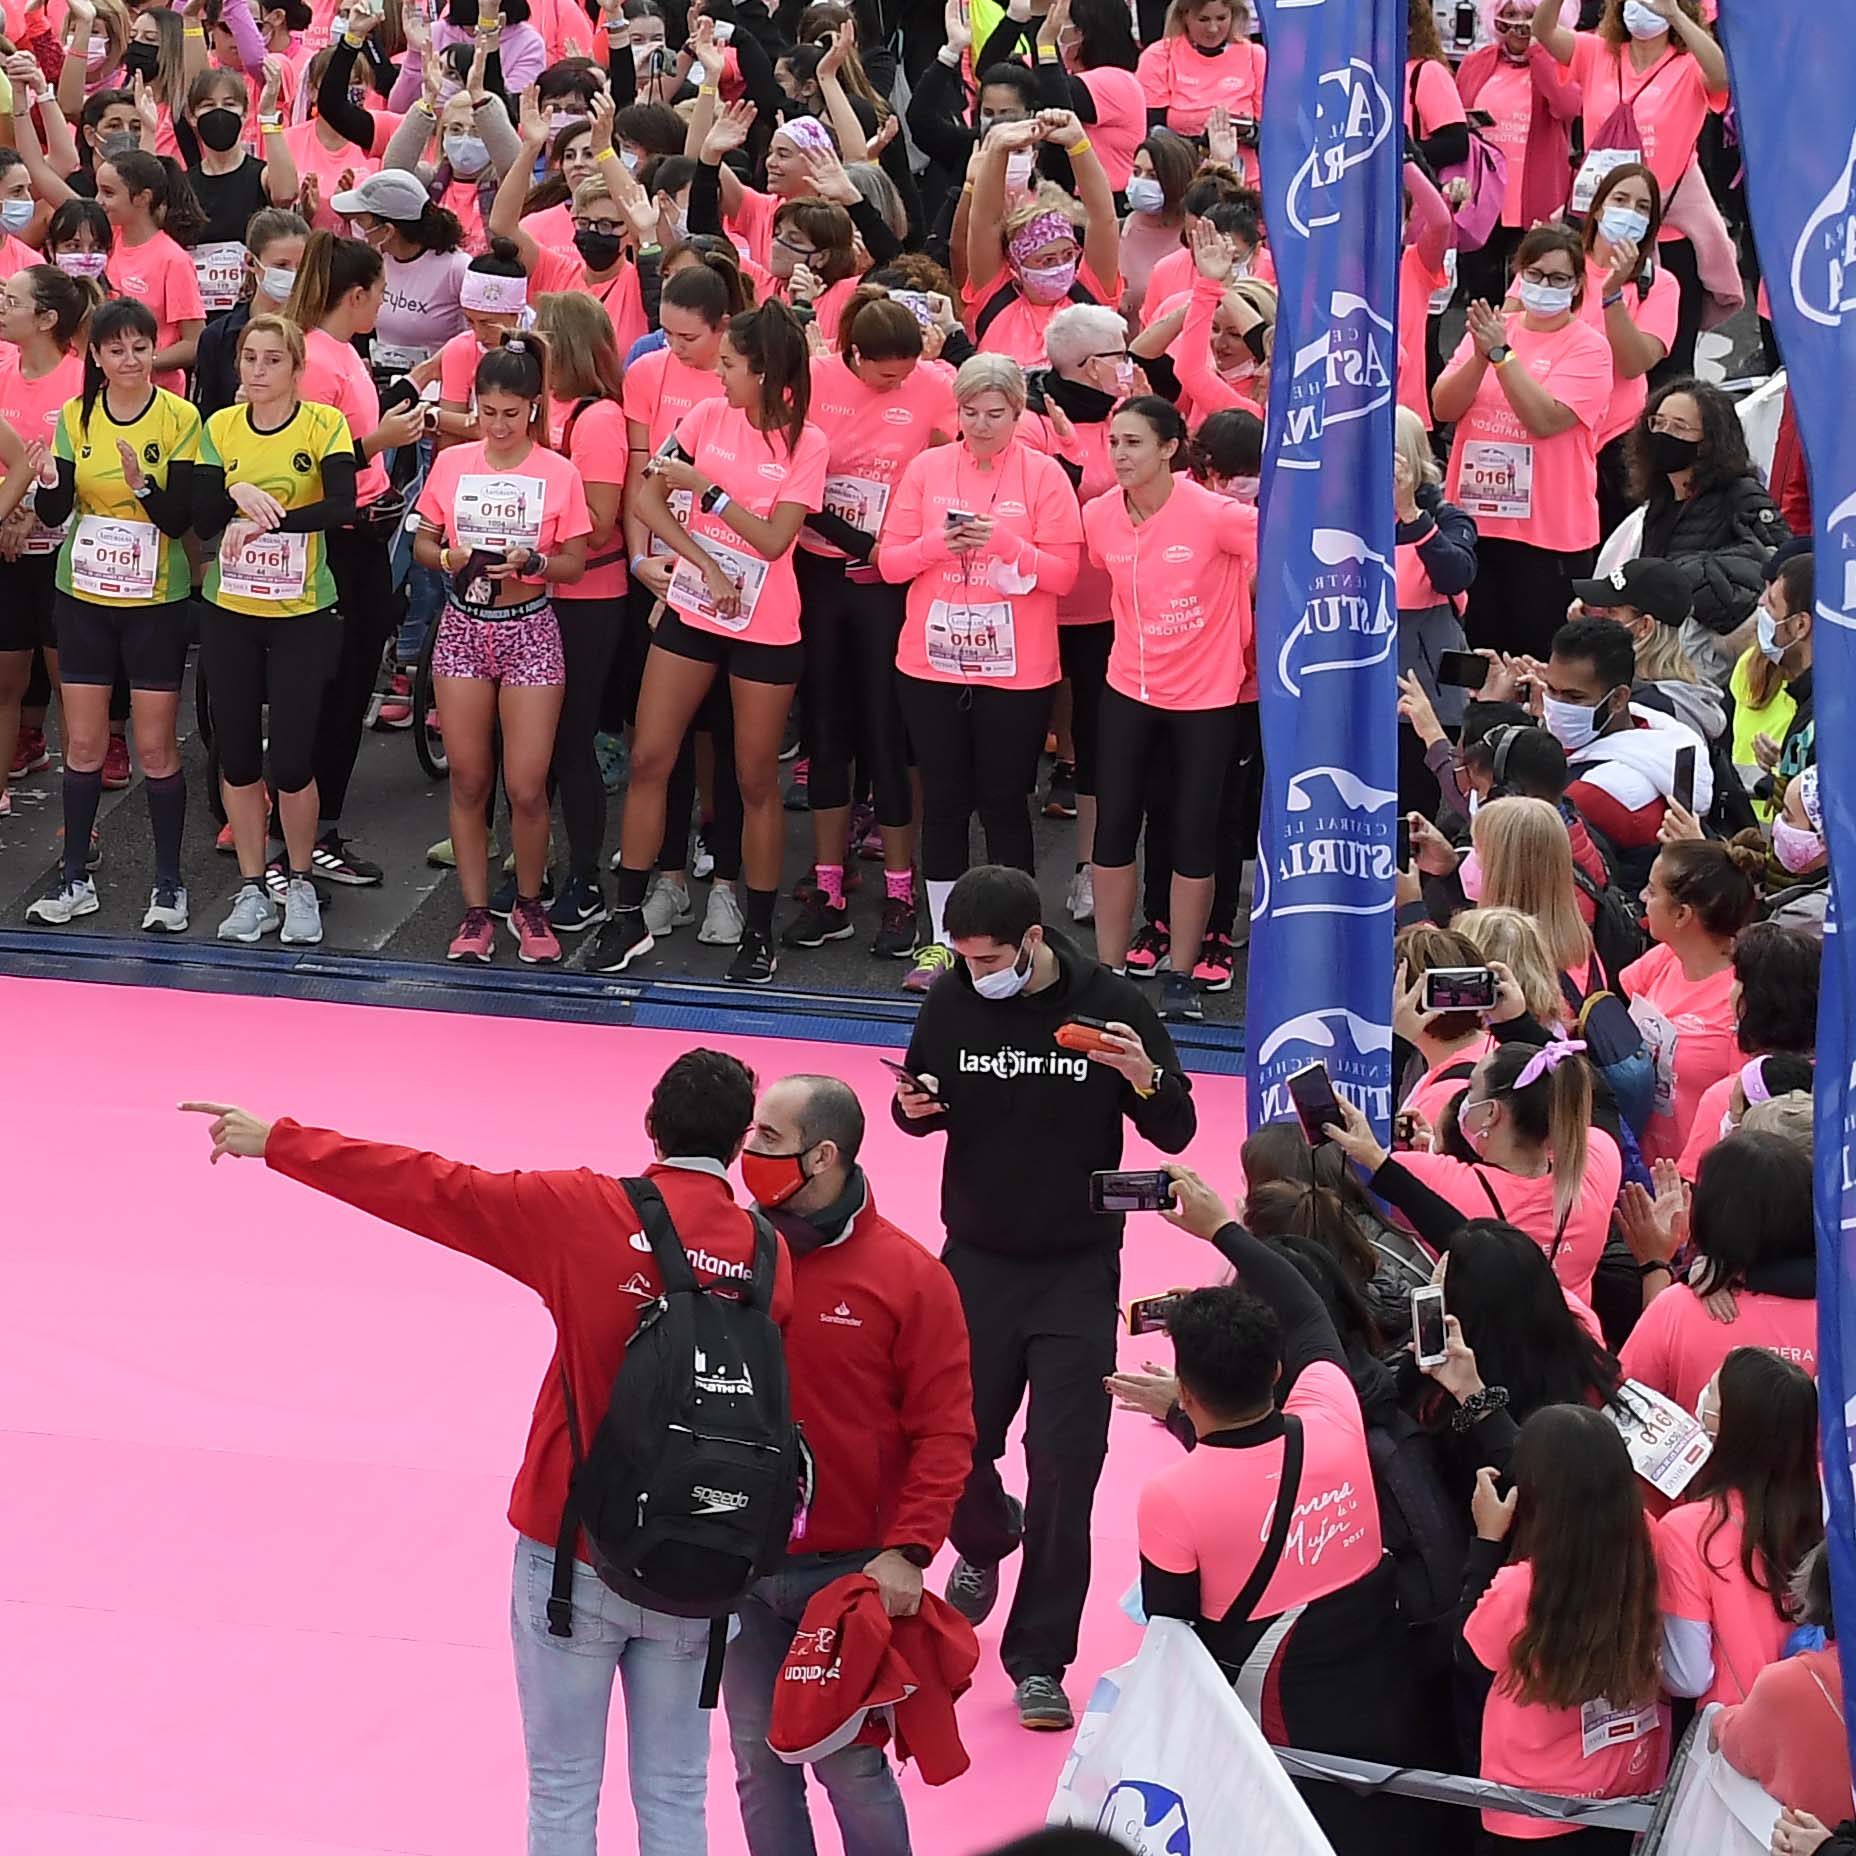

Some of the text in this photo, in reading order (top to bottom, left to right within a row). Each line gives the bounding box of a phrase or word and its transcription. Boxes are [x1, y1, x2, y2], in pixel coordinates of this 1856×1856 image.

[208, 269, 241, 282] 016
[382, 289, 430, 315] cybex
[1475, 470, 1506, 487] 016
[480, 500, 517, 521] 016
[97, 547, 132, 565] 016
[245, 551, 281, 567] 016
[951, 632, 989, 648] 016
[684, 1248, 754, 1281] ntande
[819, 1312, 864, 1328] Santander
[1641, 1410, 1673, 1445] 016
[690, 1485, 750, 1509] speedo
[1342, 1528, 1368, 1549] 2017
